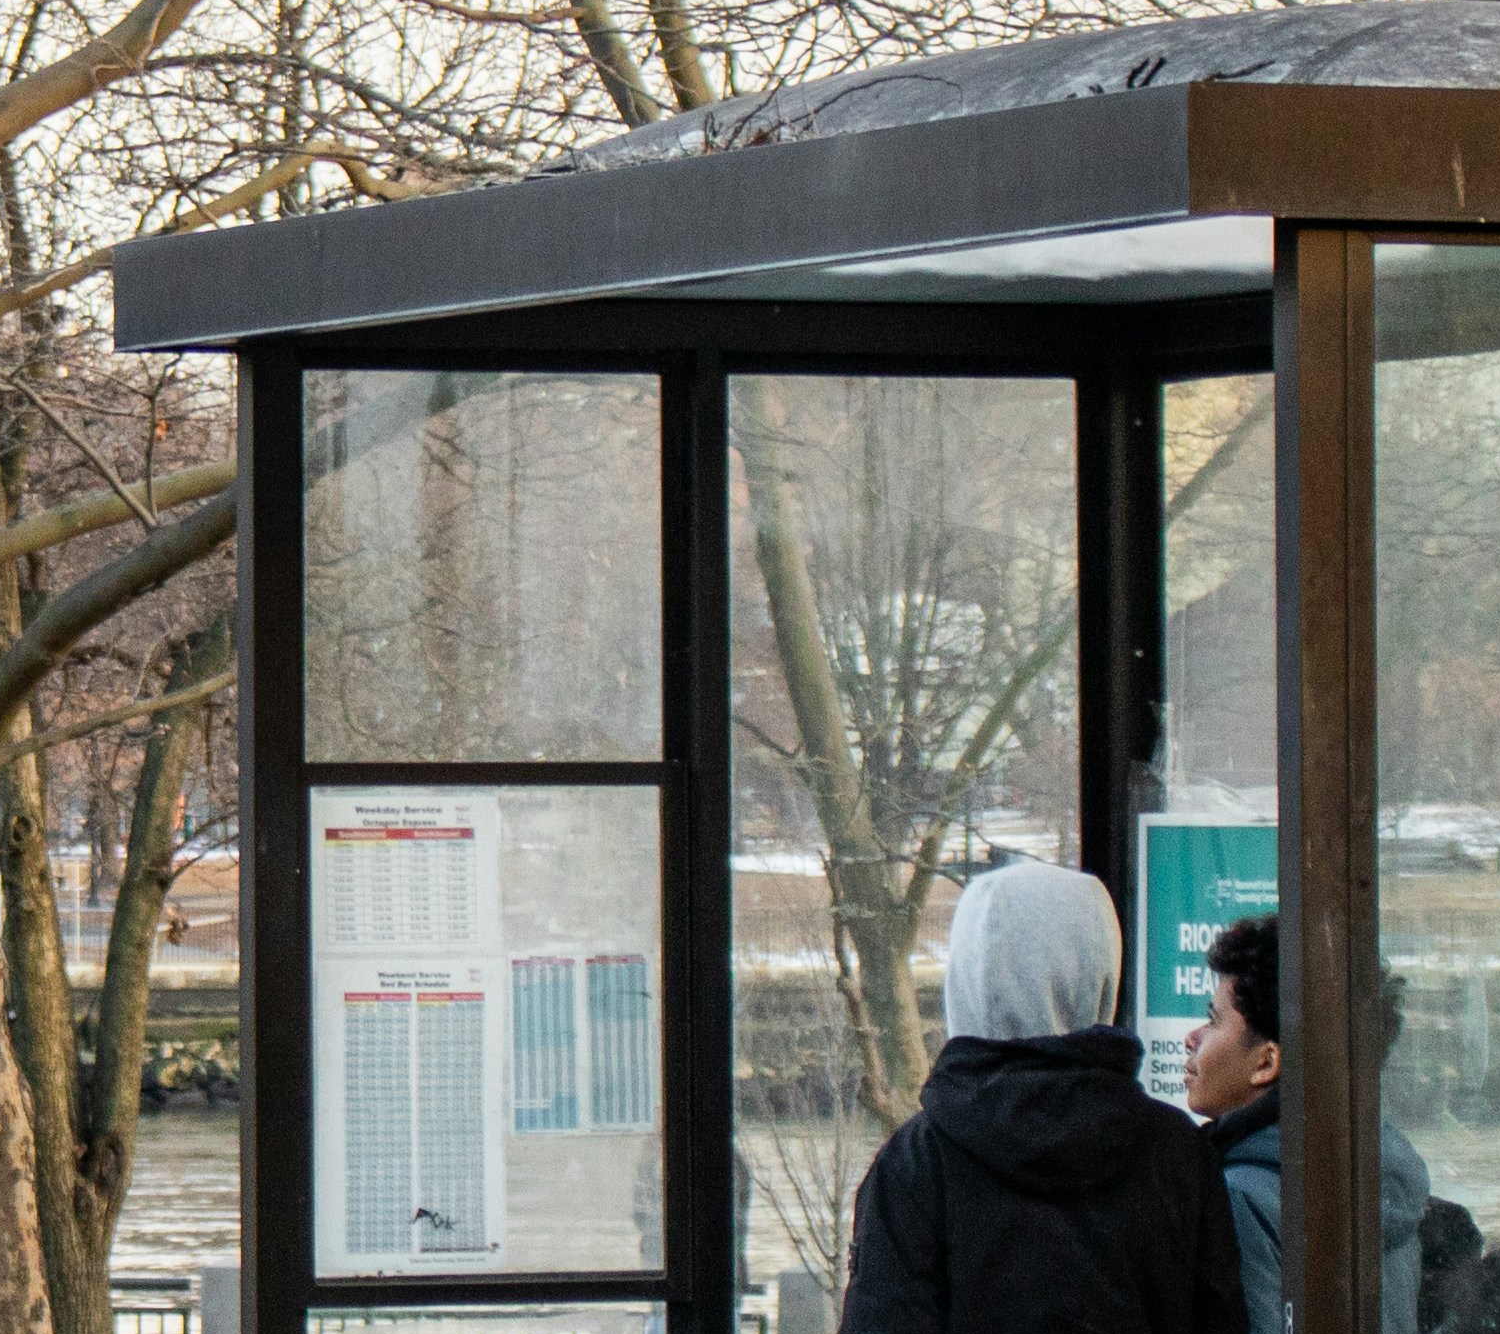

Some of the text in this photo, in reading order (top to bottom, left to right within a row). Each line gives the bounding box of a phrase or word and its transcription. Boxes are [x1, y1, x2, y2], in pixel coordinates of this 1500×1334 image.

[404, 806, 443, 814] Service
[1175, 966, 1221, 995] HEA
[1151, 1040, 1184, 1055] RIOC
